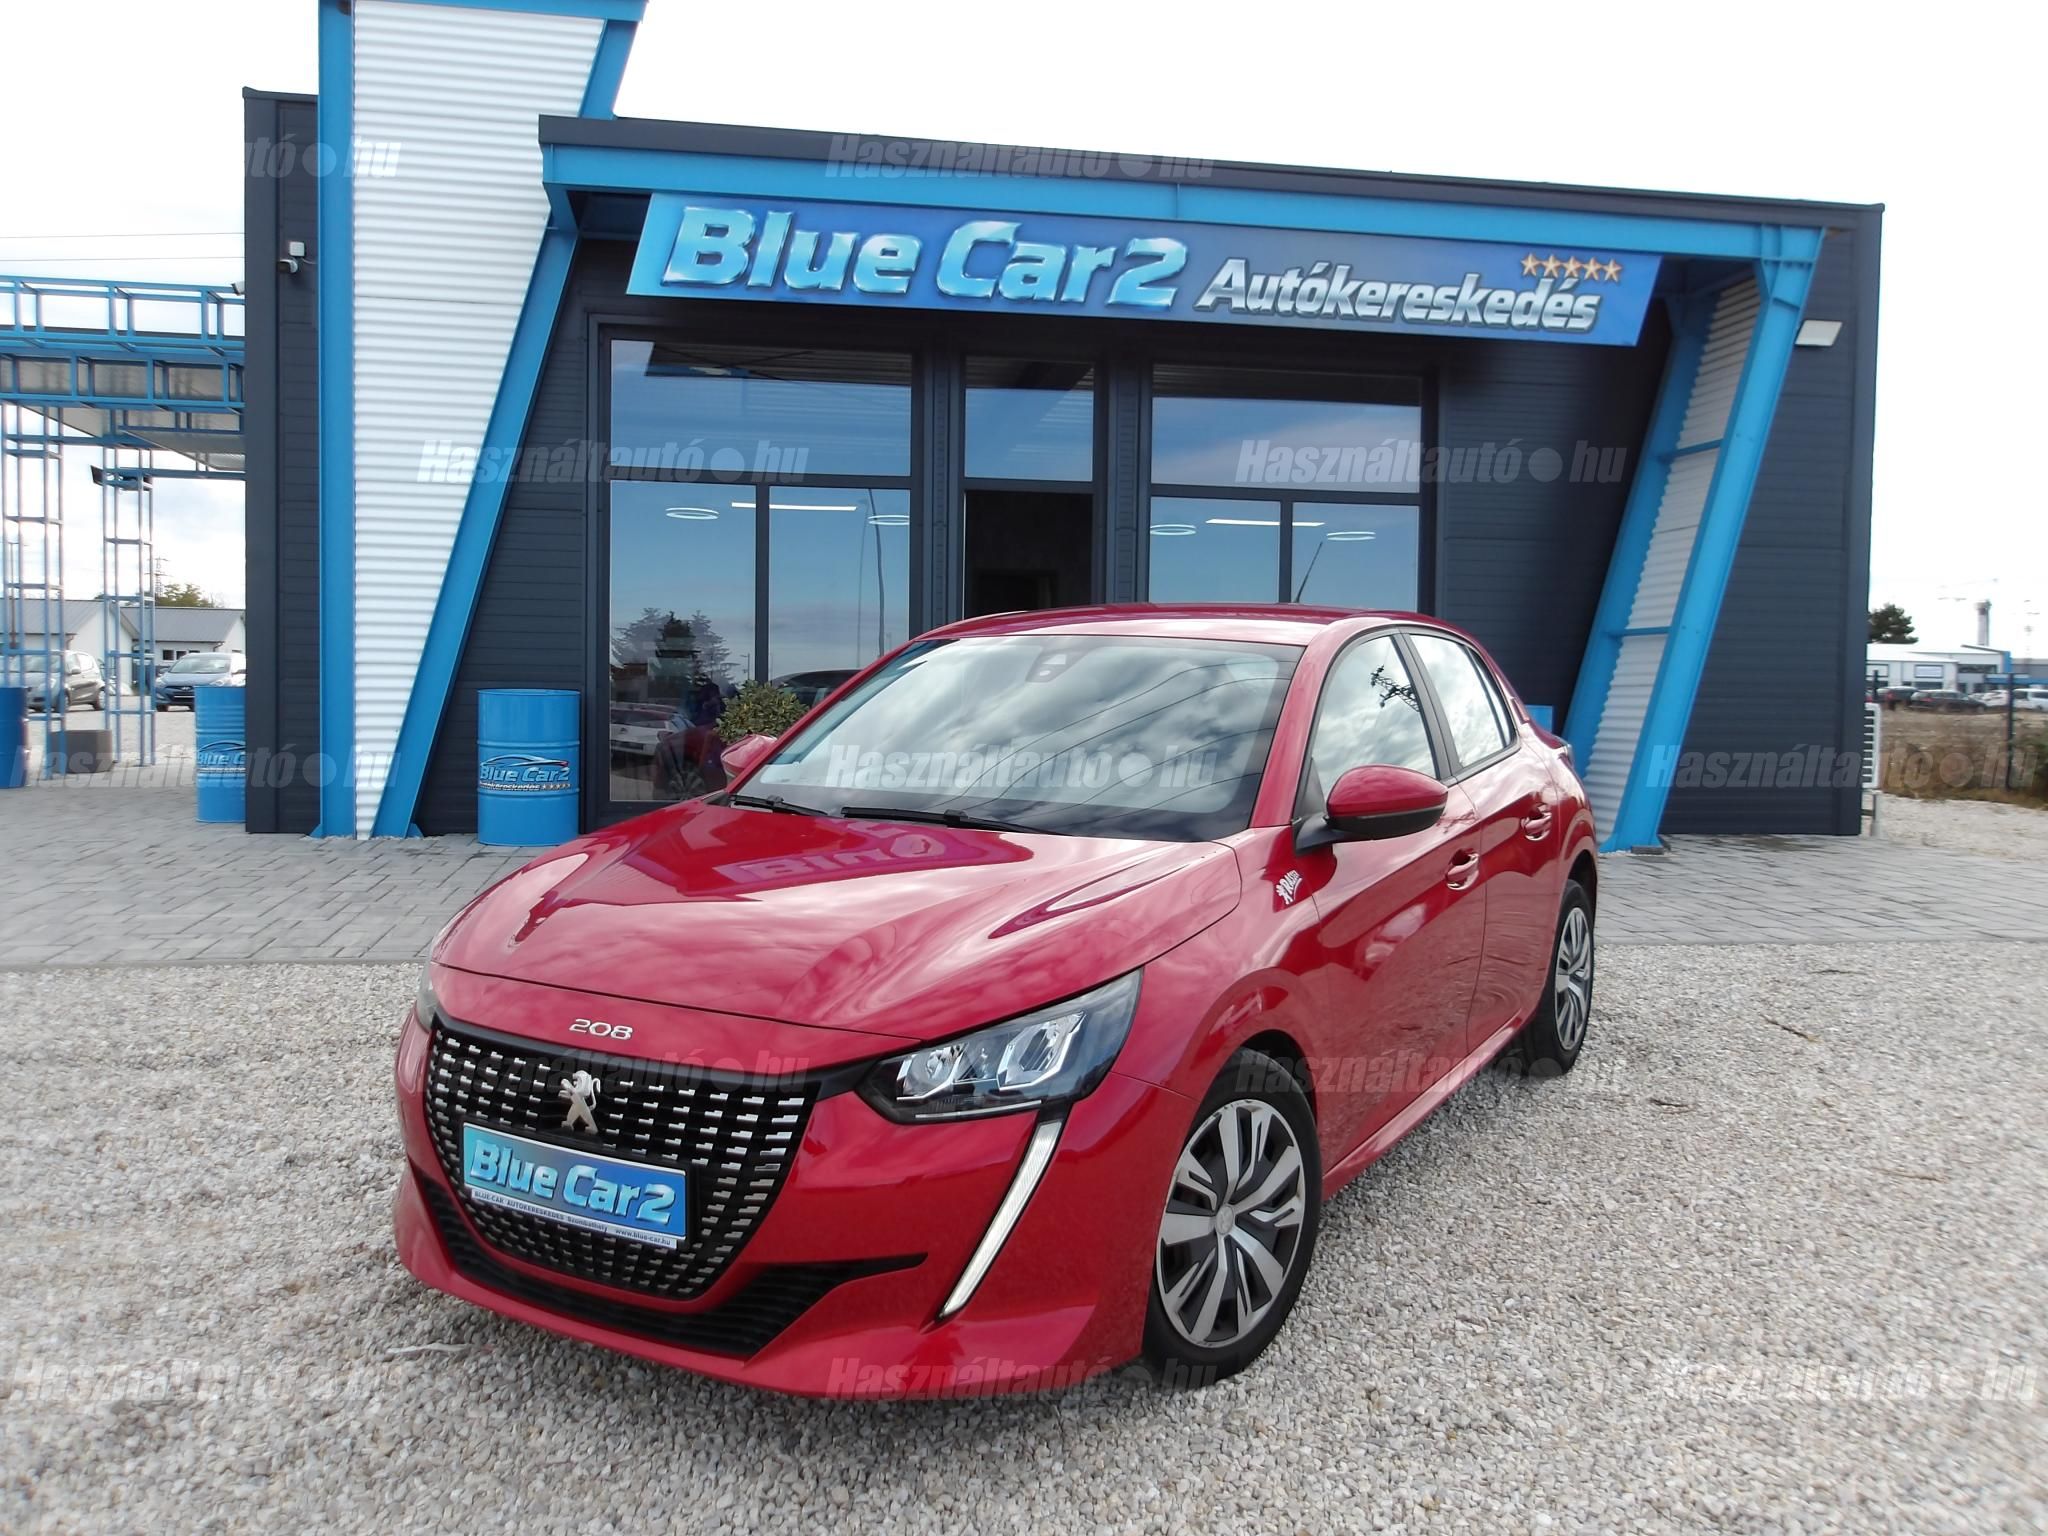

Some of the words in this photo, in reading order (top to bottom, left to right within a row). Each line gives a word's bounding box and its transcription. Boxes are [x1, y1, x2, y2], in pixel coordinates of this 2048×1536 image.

[660, 205, 922, 294] Blue
[936, 220, 1188, 309] Car2
[1194, 257, 1601, 334] Autókereskedés
[480, 765, 519, 782] Blue
[522, 766, 570, 782] Car2
[569, 1018, 634, 1040] 208
[470, 1139, 559, 1199] Blue
[563, 1164, 676, 1226] Car2
